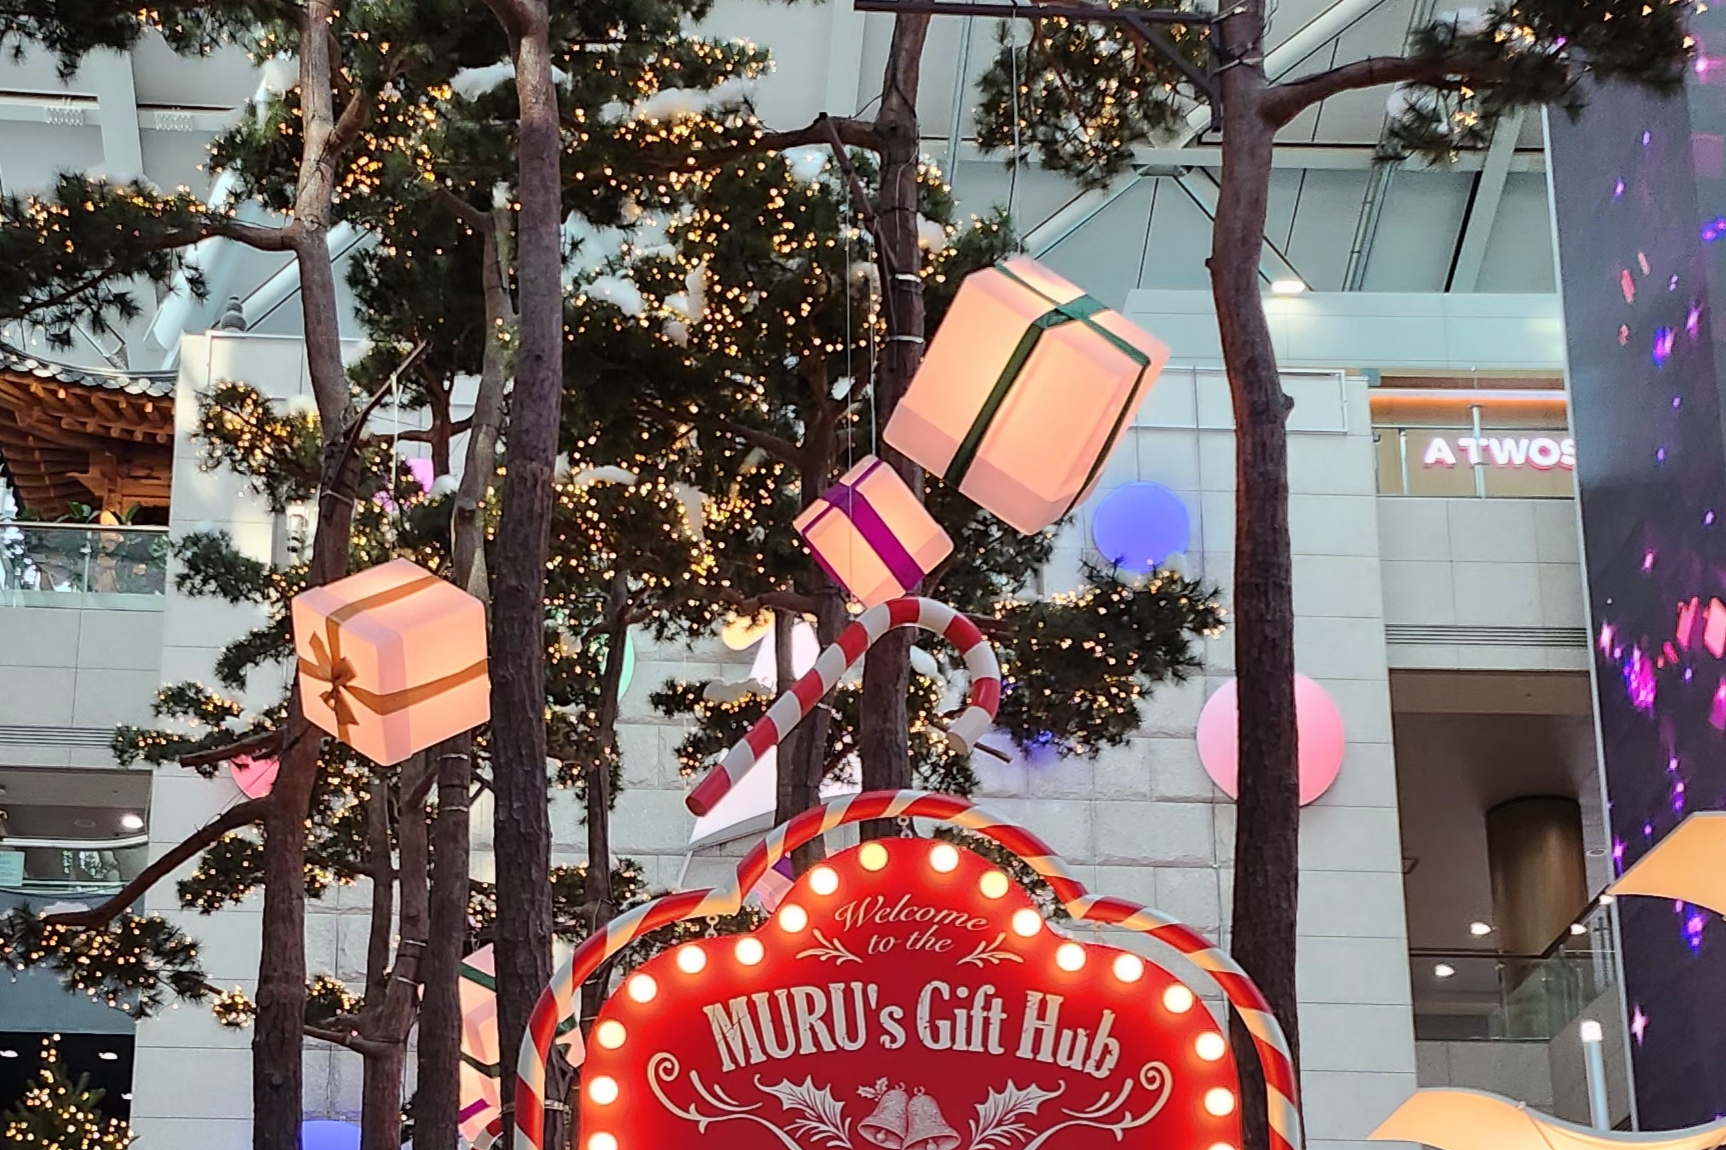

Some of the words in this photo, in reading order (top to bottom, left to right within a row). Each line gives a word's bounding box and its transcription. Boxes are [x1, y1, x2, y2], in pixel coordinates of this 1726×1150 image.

[834, 894, 990, 932] Welcome
[868, 934, 901, 955] to
[905, 925, 954, 953] the
[703, 981, 906, 1073] MURU's
[916, 980, 1007, 1055] Gift
[1015, 990, 1120, 1079] Hub
